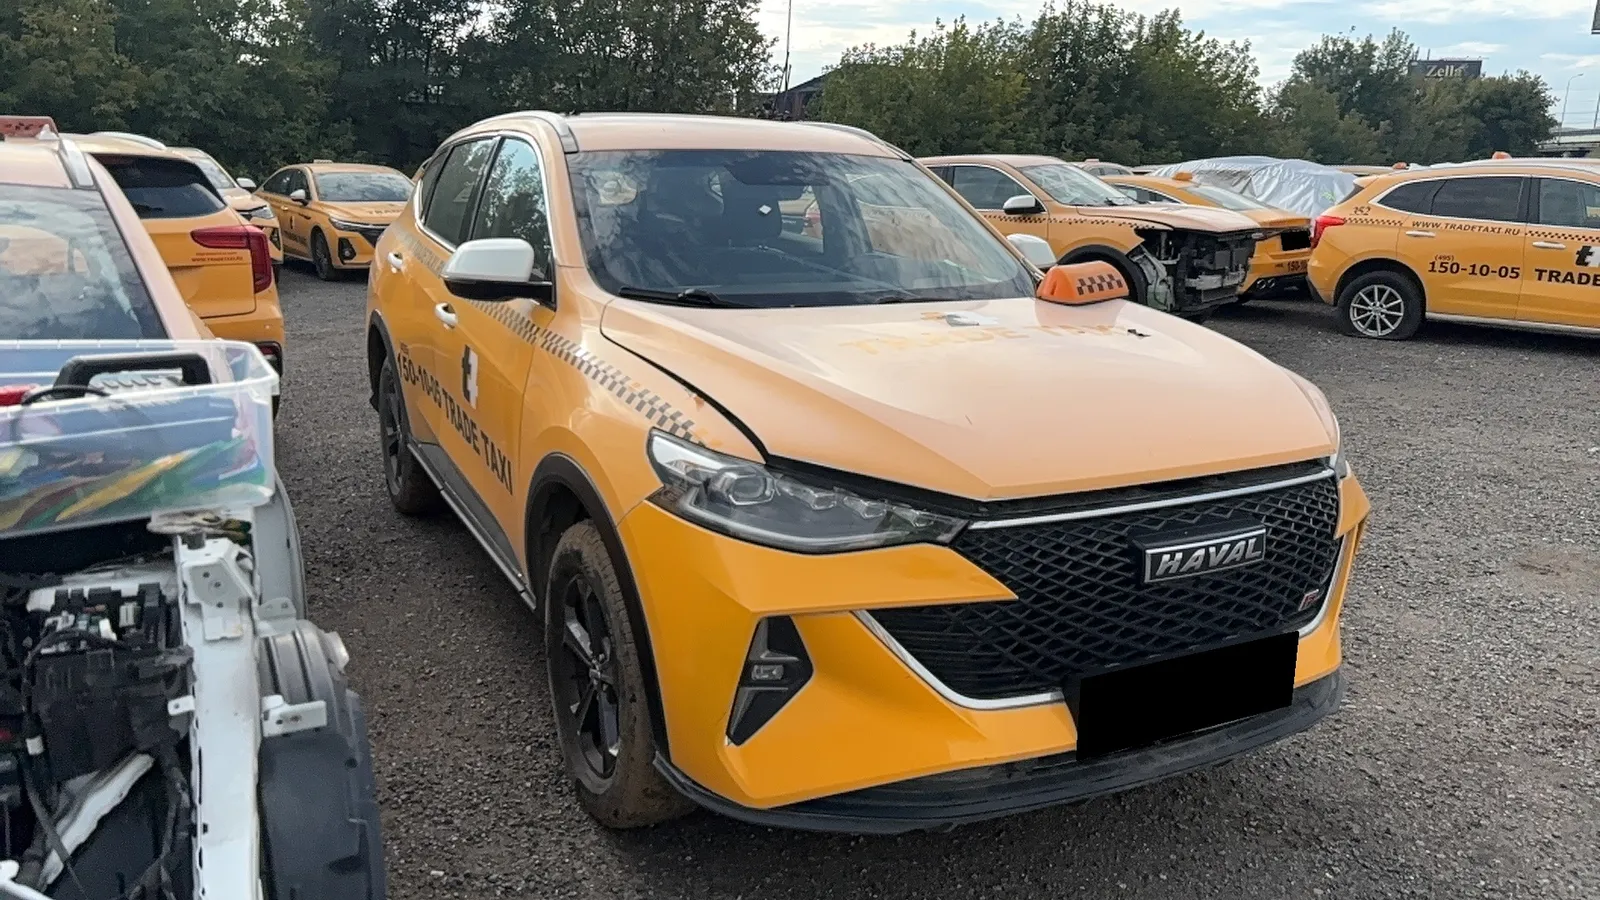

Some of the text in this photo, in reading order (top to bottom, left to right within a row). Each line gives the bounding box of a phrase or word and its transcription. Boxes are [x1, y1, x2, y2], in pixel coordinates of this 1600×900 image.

[1411, 220, 1521, 236] WWW.TRADETAXI.RU
[1428, 261, 1521, 279] 150-10-05
[1534, 268, 1600, 287] TRADE
[397, 352, 513, 496] 150-10-05 TRADE TAXI
[1155, 537, 1262, 576] HAVAL
